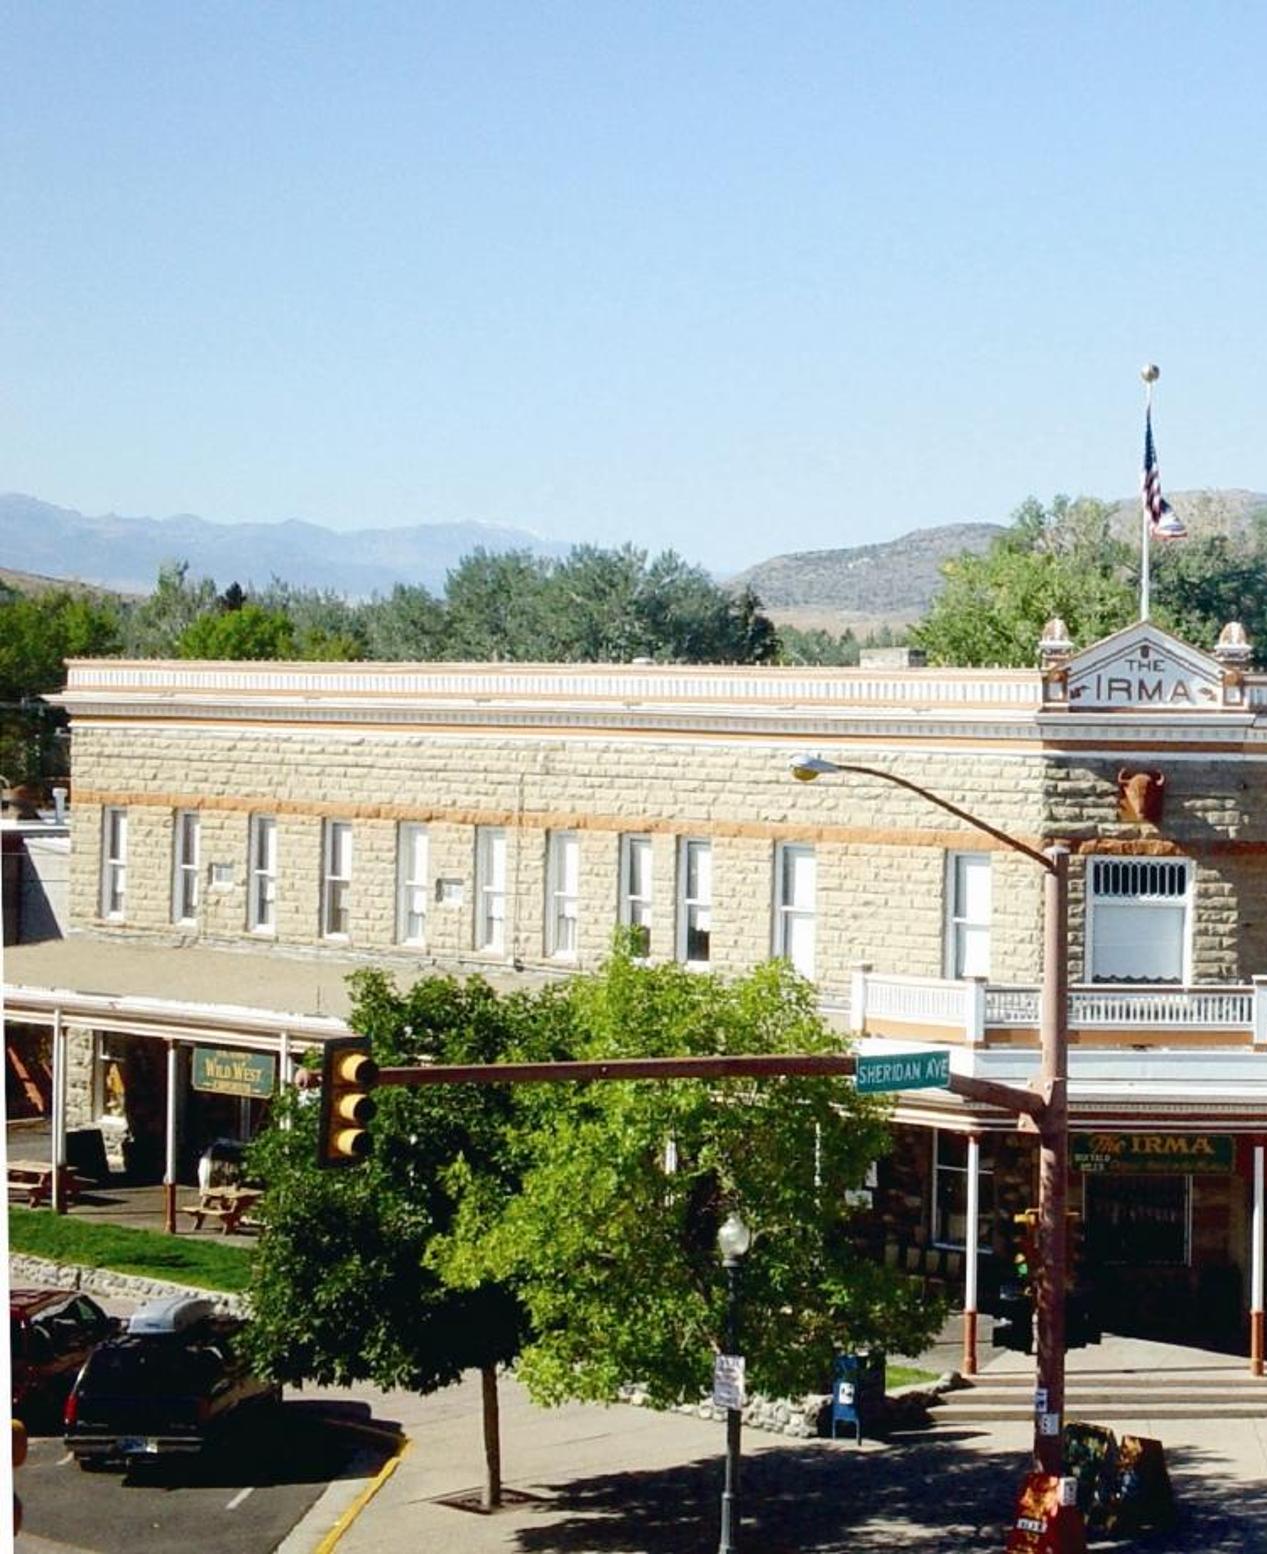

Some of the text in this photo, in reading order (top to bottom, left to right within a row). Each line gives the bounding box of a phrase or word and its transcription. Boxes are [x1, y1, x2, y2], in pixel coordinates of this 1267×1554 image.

[1124, 658, 1166, 673] THE
[1095, 674, 1191, 701] IRMA
[859, 1057, 948, 1084] SHERIDAN AVE
[1130, 1135, 1215, 1154] IRMA
